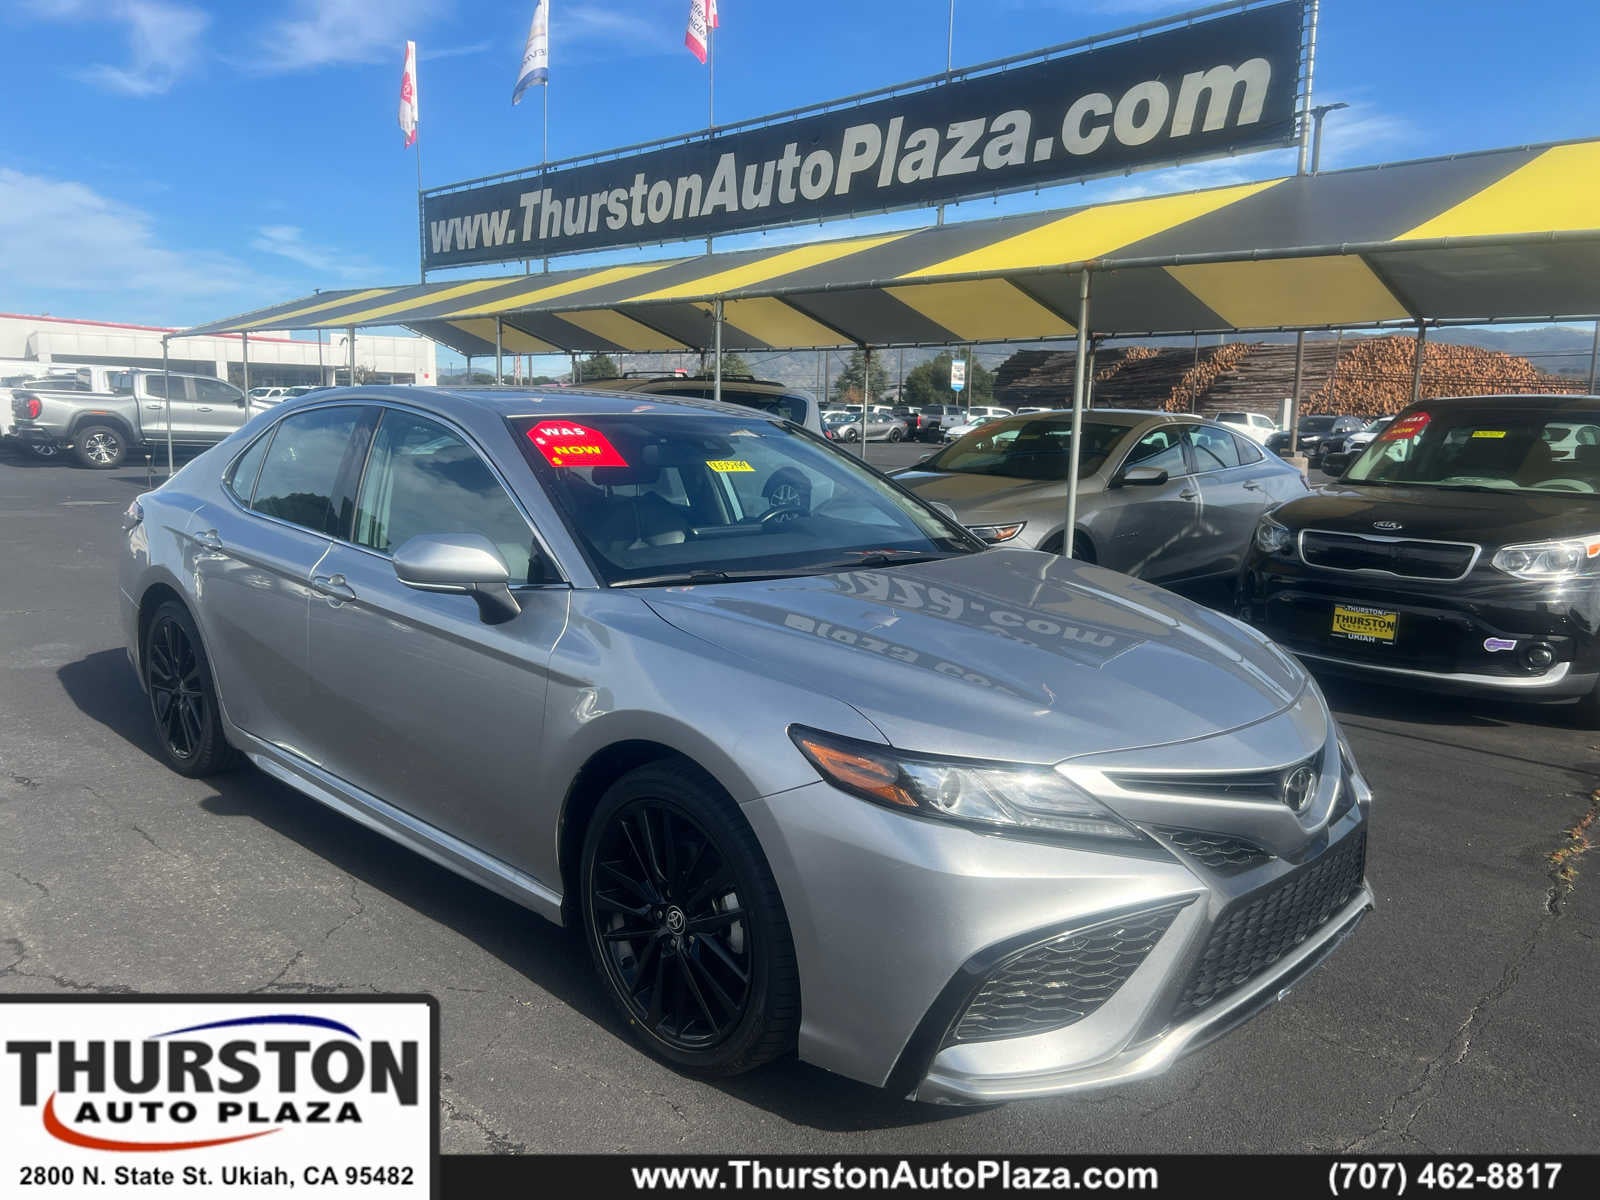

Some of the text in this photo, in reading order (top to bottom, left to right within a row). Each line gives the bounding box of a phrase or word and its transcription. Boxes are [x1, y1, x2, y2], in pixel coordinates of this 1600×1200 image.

[430, 57, 1272, 255] www.ThurstonAutoPlaza.com
[540, 427, 585, 436] WAS
[553, 446, 601, 454] NOW
[1346, 606, 1384, 616] THURSTON
[1335, 614, 1394, 632] THURSTON
